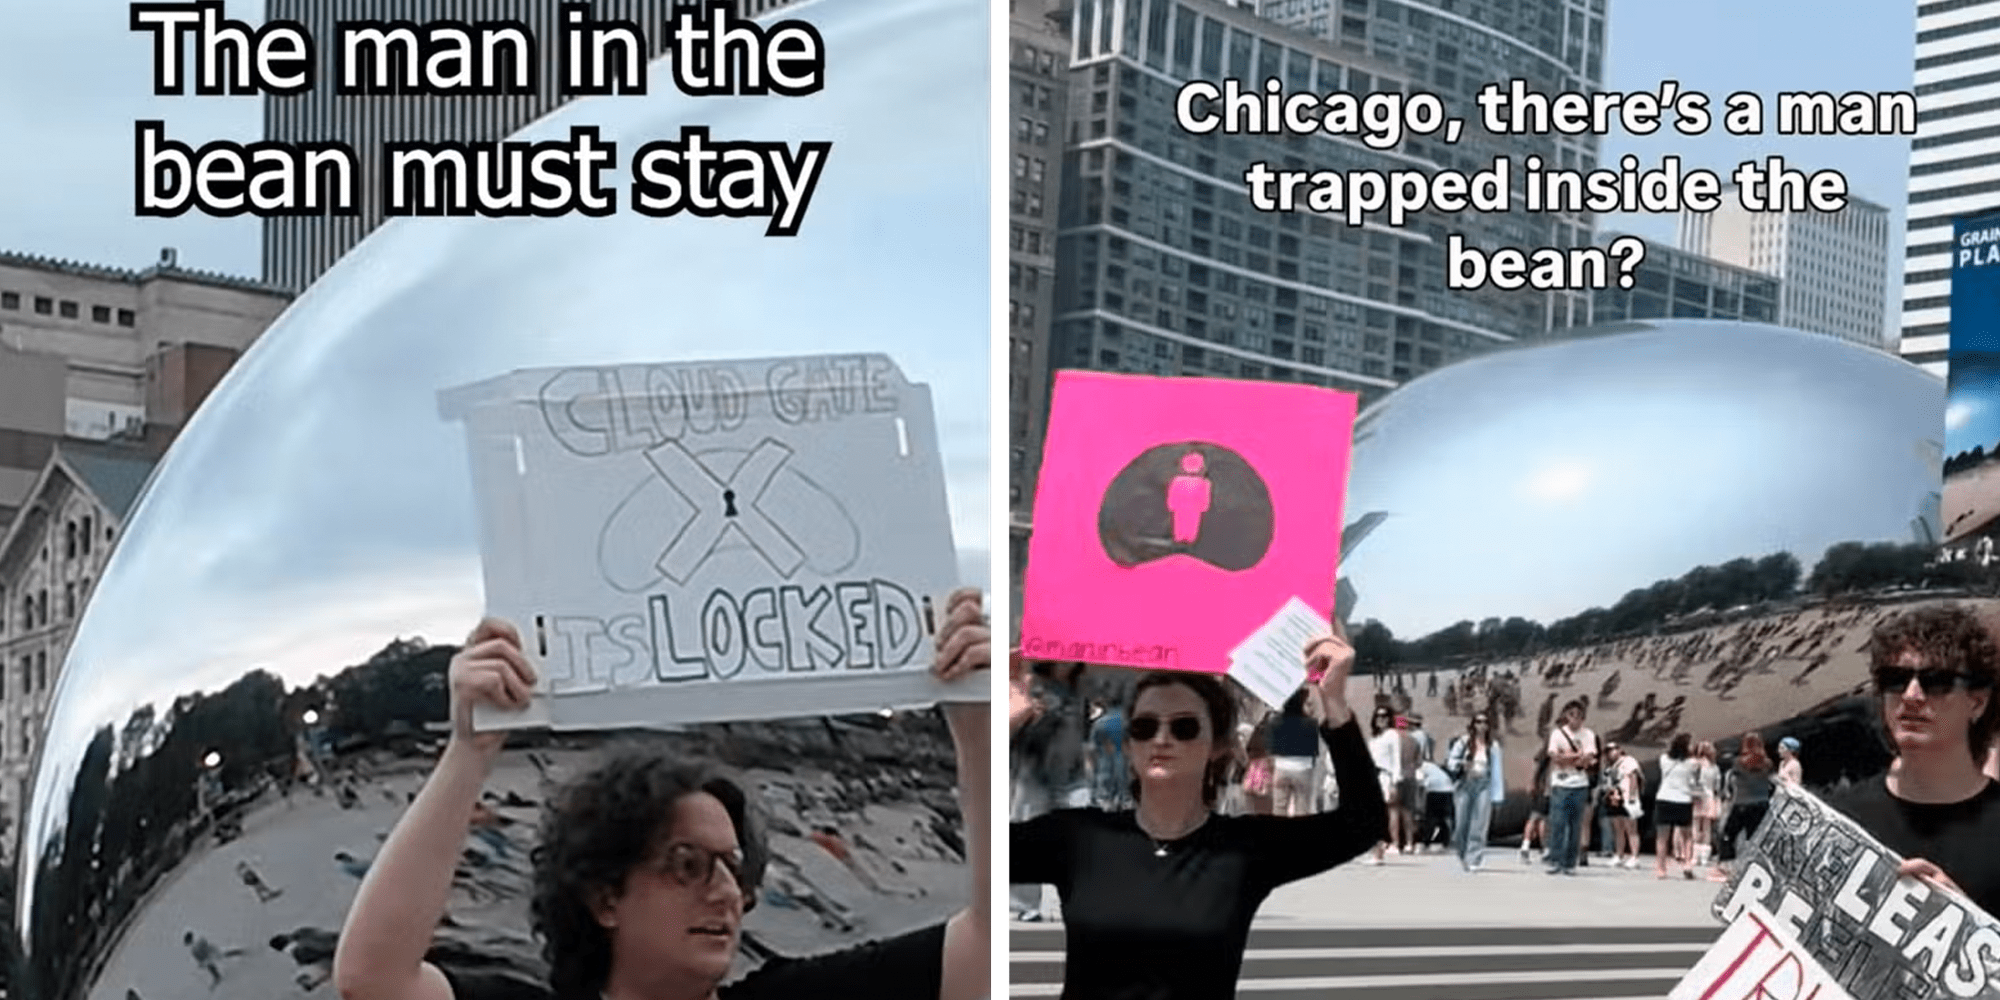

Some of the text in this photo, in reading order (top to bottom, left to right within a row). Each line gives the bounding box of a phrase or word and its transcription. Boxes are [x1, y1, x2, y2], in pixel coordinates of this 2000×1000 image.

[539, 353, 900, 457] CLOUD GATE
[550, 578, 925, 695] IS LOCKED
[1698, 910, 1822, 1000] TR
